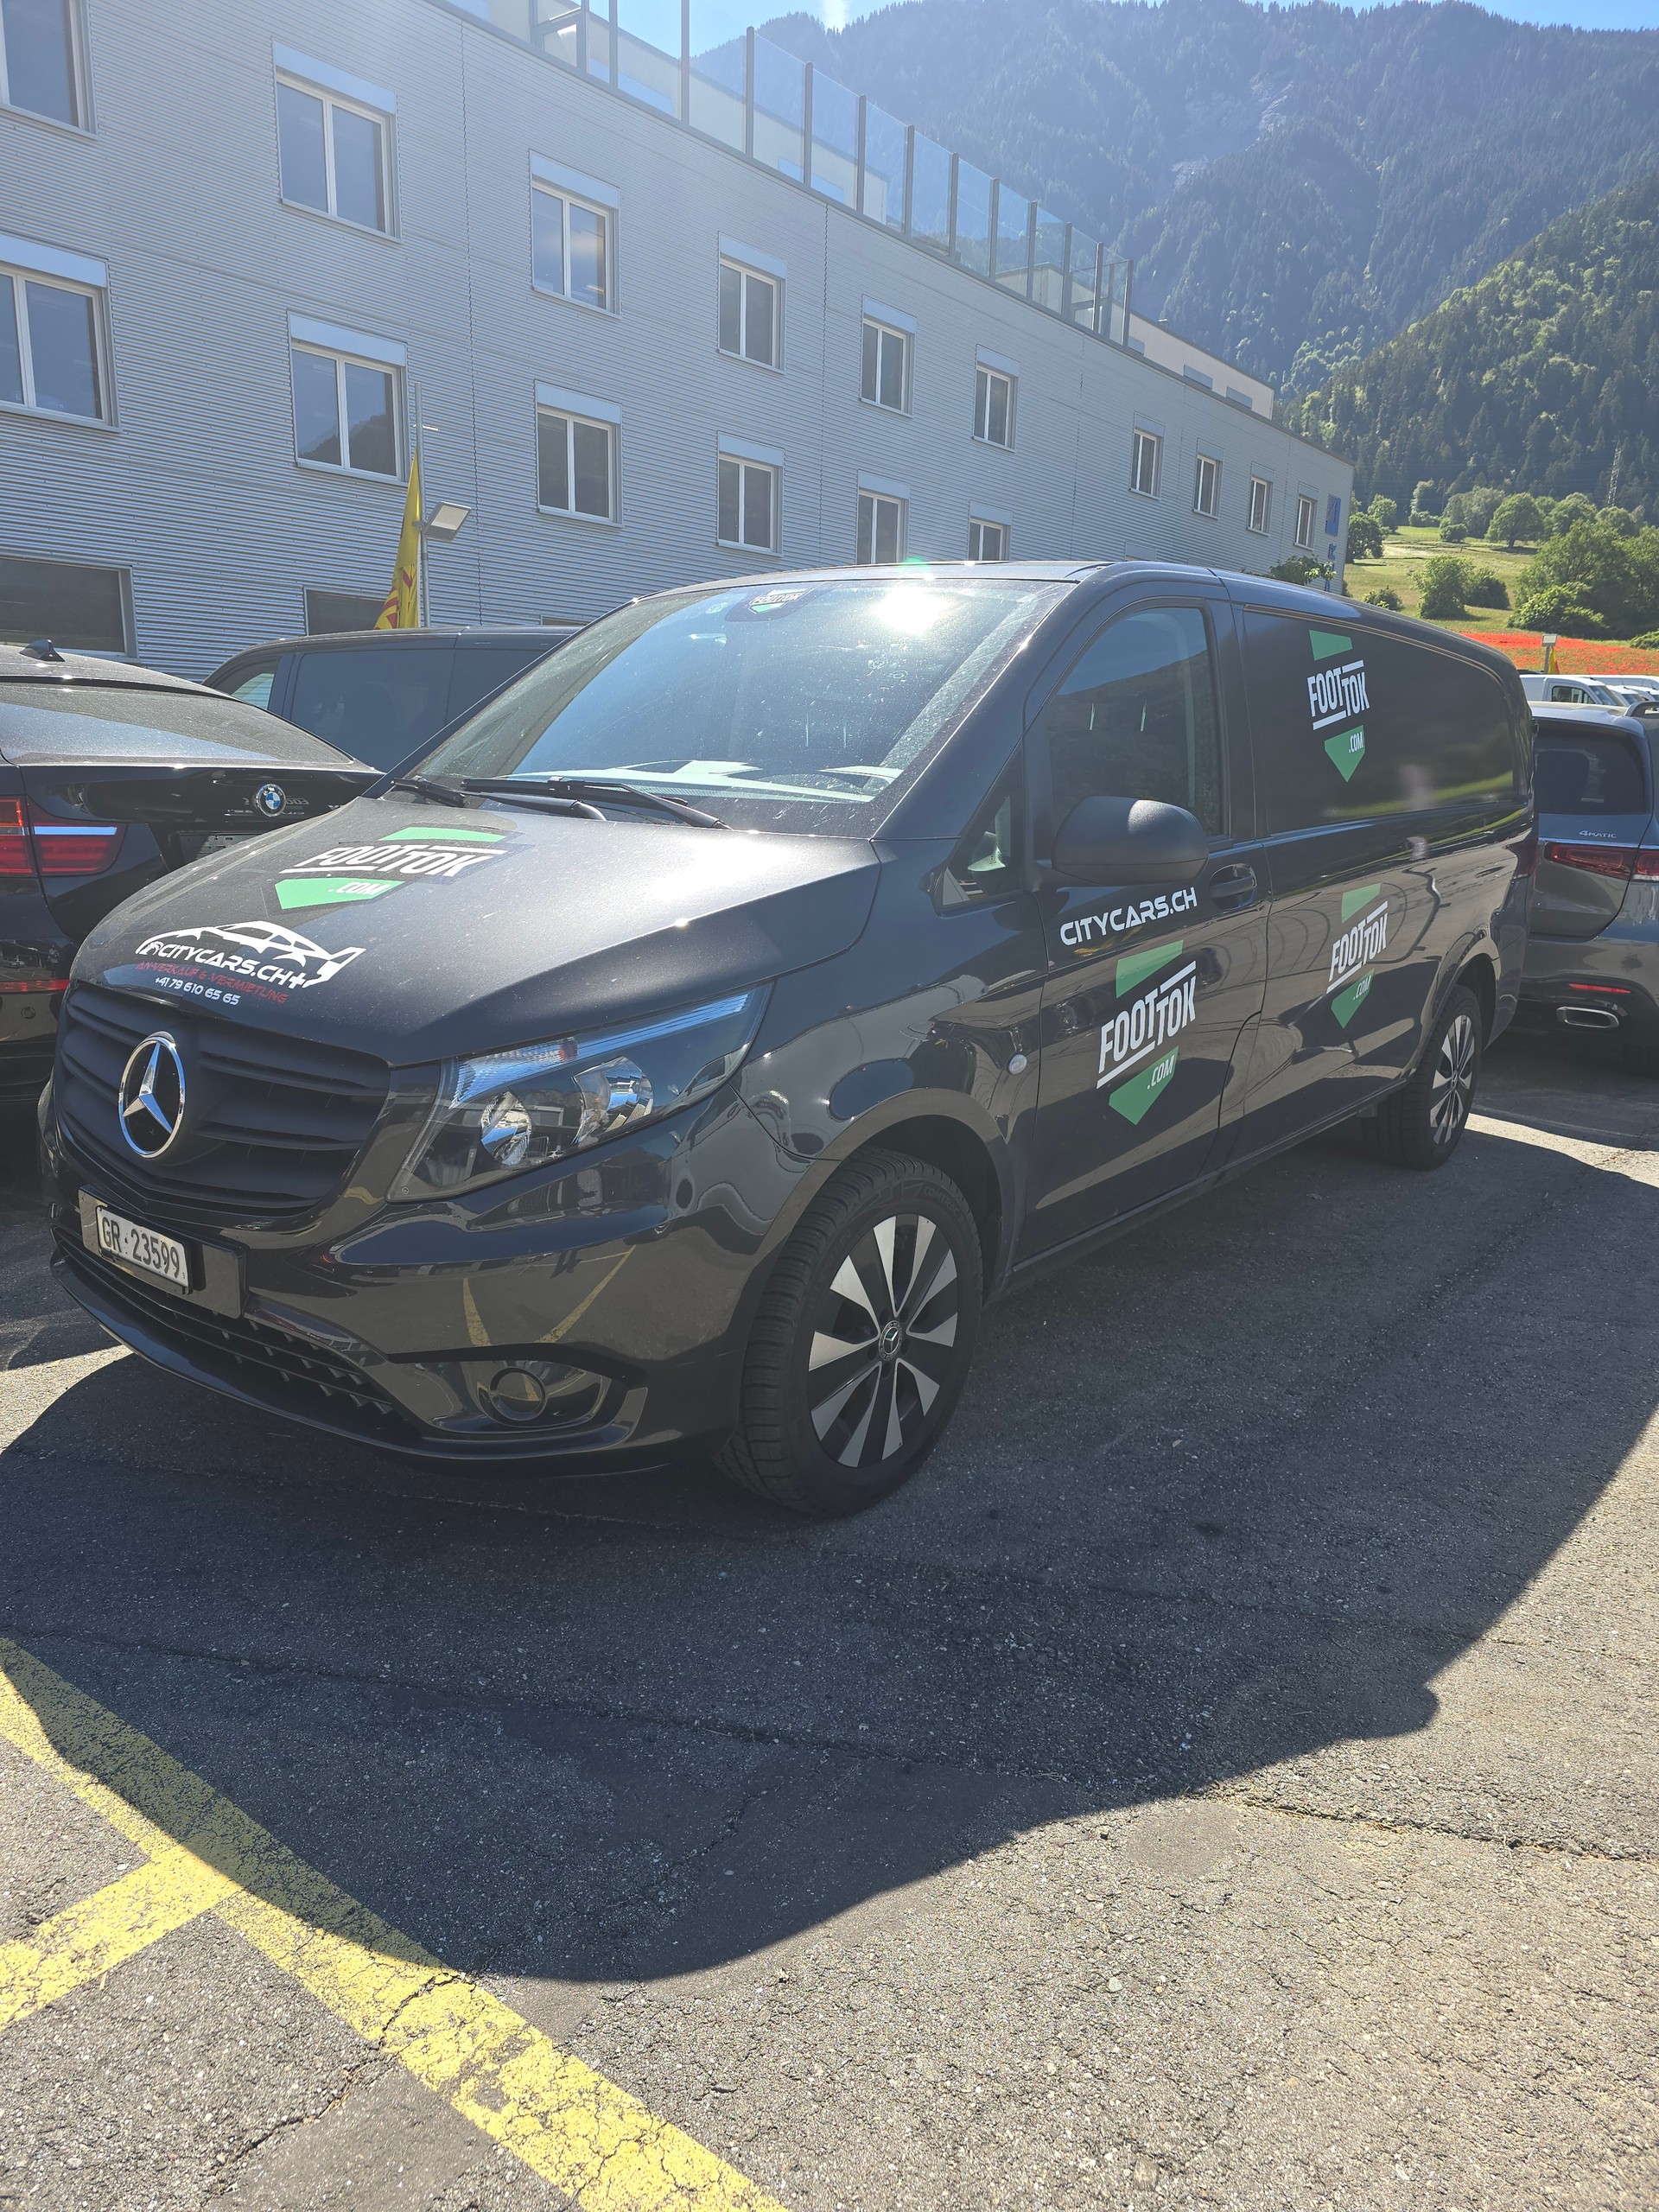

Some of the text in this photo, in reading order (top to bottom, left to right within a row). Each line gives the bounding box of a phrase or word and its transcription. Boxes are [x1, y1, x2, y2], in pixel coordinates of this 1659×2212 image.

[1059, 887, 1198, 946] CITYCARS.CH
[156, 976, 241, 1005] +41 79 610 65 65
